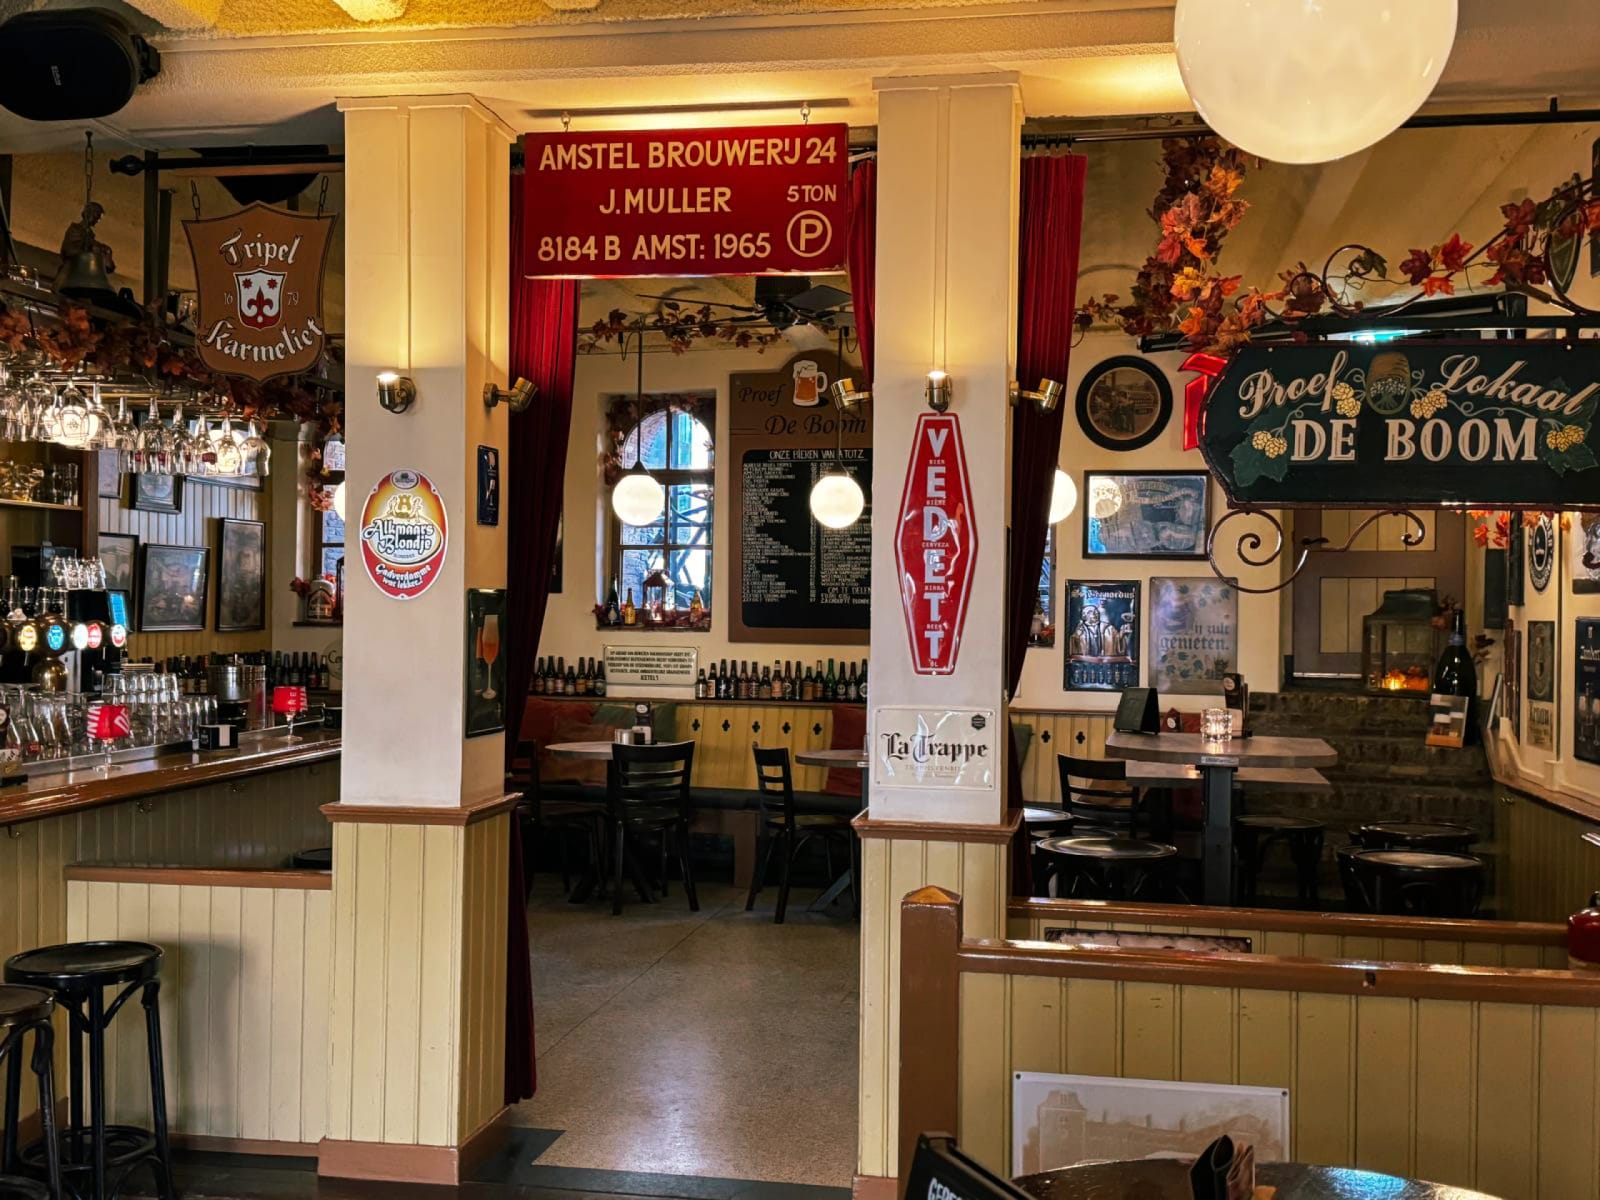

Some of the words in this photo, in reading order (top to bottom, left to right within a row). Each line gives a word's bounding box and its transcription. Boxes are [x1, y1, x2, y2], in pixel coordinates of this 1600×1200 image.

[539, 143, 640, 170] AMSTEL
[806, 137, 836, 164] 24
[220, 228, 302, 267] Tripel
[538, 235, 598, 261] 8184
[604, 235, 621, 261] B
[632, 233, 705, 260] AMST:
[714, 233, 771, 259] 1965
[204, 317, 323, 361] Karmeliet
[739, 384, 787, 407] Proef
[1239, 350, 1349, 418] Proef
[1431, 354, 1600, 416] Lokaal
[765, 415, 797, 435] De
[803, 414, 866, 434] Boom
[1291, 418, 1358, 461] DE
[1384, 418, 1539, 462] BOOM
[769, 449, 791, 459] ONZE
[821, 449, 836, 459] VAN
[363, 518, 435, 542] Alkmaars
[378, 535, 432, 555] Blondje
[924, 428, 949, 660] VEDETT
[881, 732, 909, 761] La
[910, 734, 989, 763] Trappe
